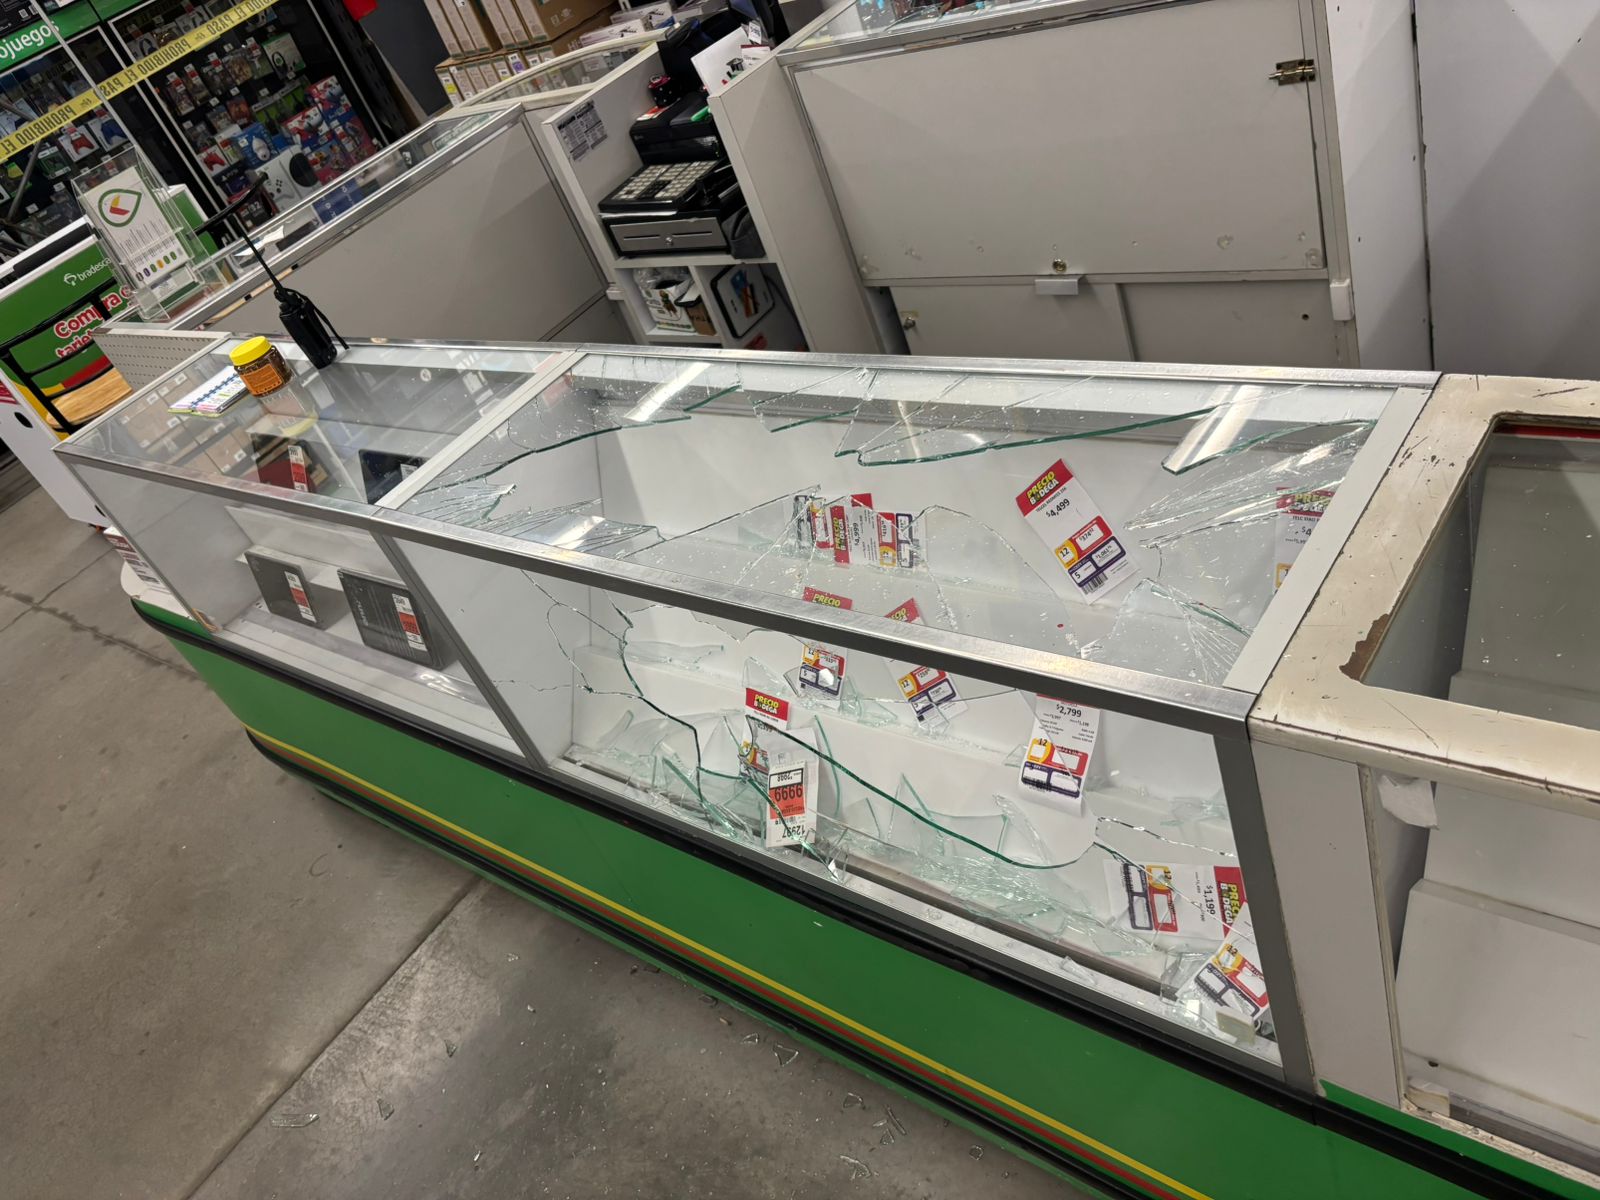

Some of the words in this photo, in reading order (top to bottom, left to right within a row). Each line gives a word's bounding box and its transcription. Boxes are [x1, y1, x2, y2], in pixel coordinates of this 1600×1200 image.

[1027, 471, 1055, 498] PRECIO
[1029, 479, 1060, 505] BODEGA
[1046, 498, 1070, 518] $4,499
[833, 517, 841, 550] PRECIO
[1060, 547, 1070, 558] 12
[813, 593, 840, 607] PRECIO
[901, 680, 910, 688] 12
[755, 694, 779, 708] PRECIO
[1056, 704, 1082, 718] $2,799
[1039, 738, 1048, 746] 12
[775, 785, 803, 802] 9999
[1164, 870, 1172, 880] 12
[1227, 945, 1238, 956] 12
